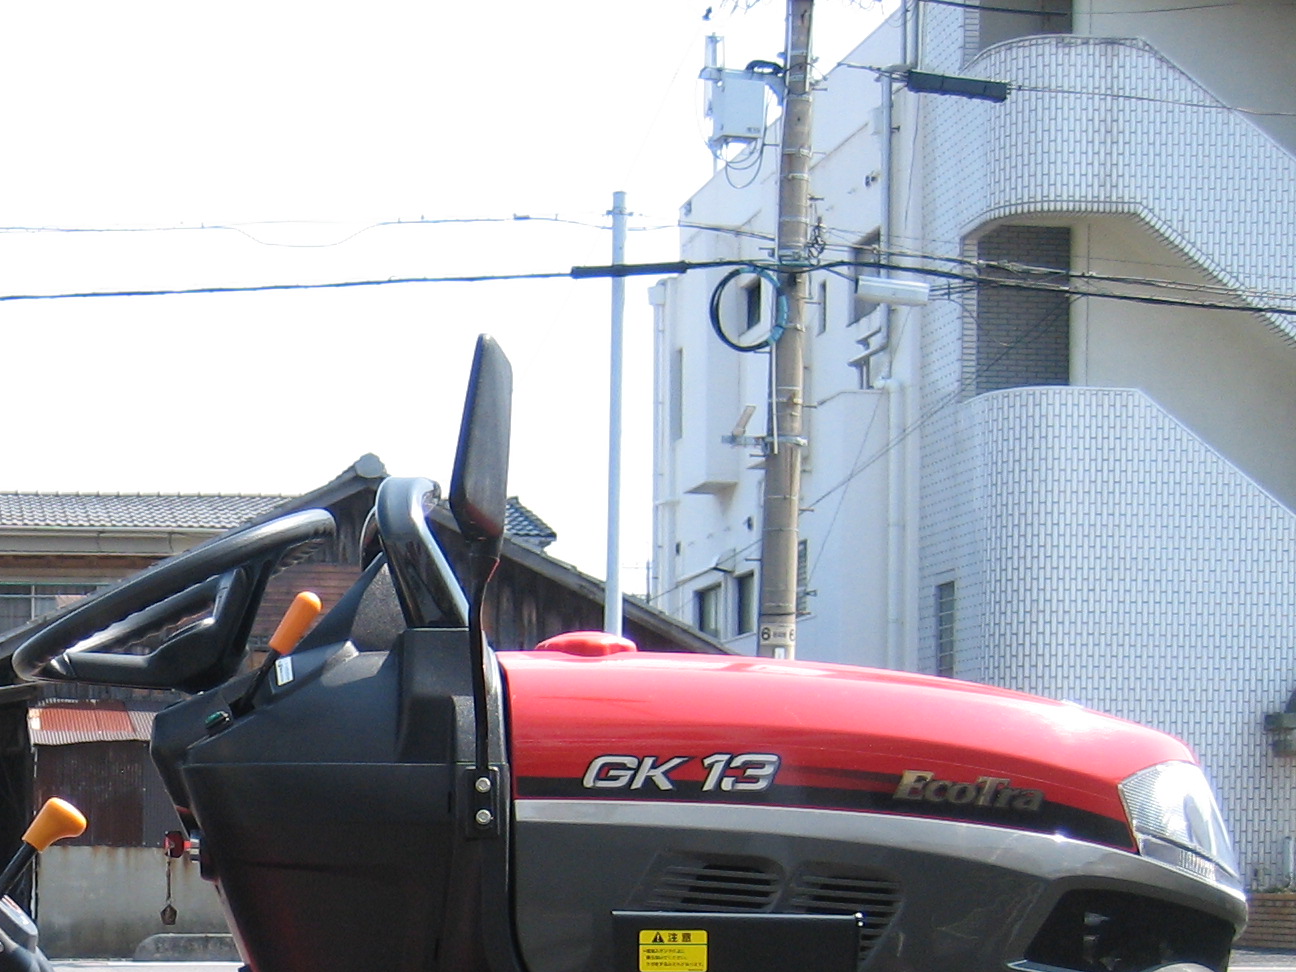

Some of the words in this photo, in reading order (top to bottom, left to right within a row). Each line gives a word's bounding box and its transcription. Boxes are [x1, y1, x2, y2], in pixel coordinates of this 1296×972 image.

[583, 754, 694, 791] GK
[702, 752, 781, 792] 13
[893, 769, 1044, 810] EcoTra
